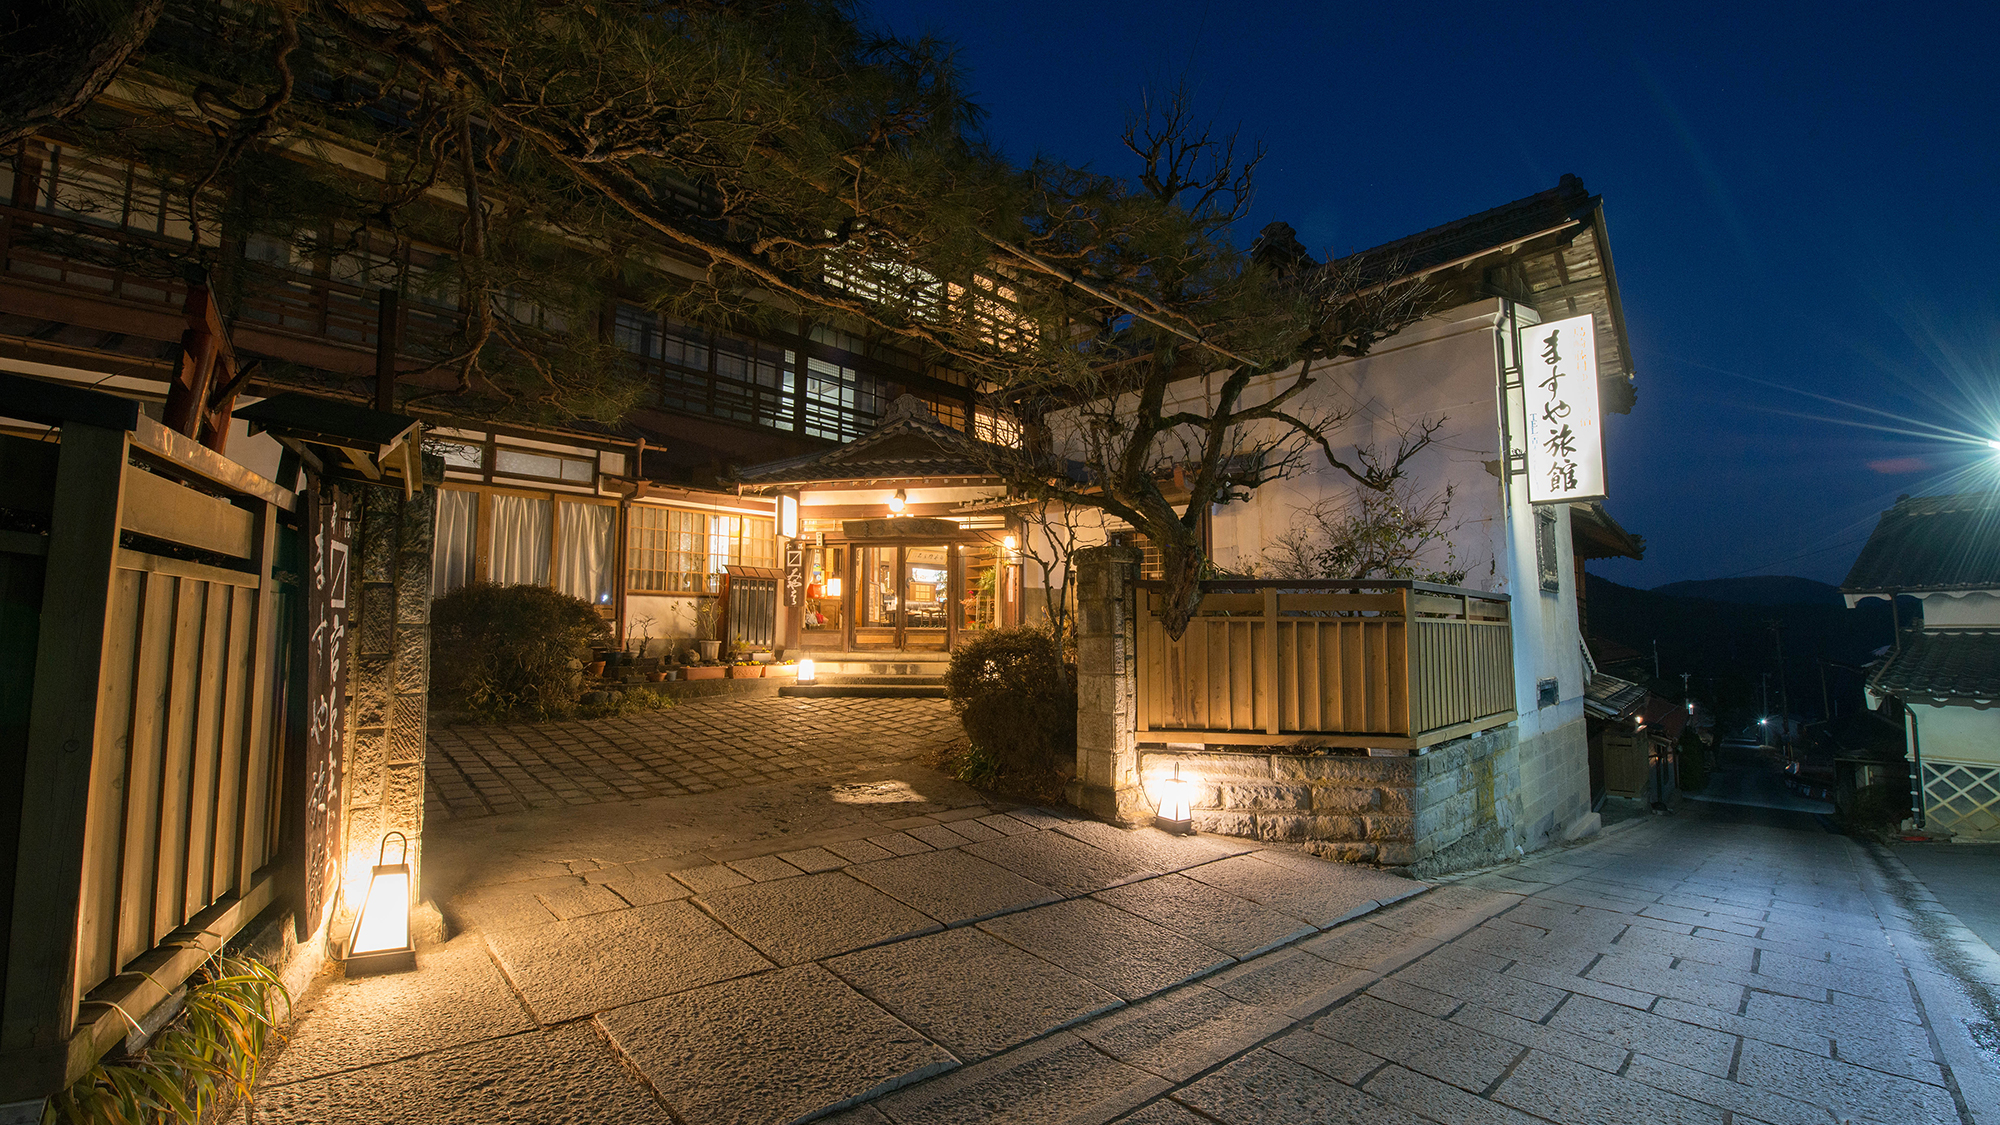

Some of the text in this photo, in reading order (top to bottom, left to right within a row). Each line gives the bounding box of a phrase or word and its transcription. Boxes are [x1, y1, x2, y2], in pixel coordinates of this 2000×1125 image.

[1538, 329, 1578, 492] ますや旅館
